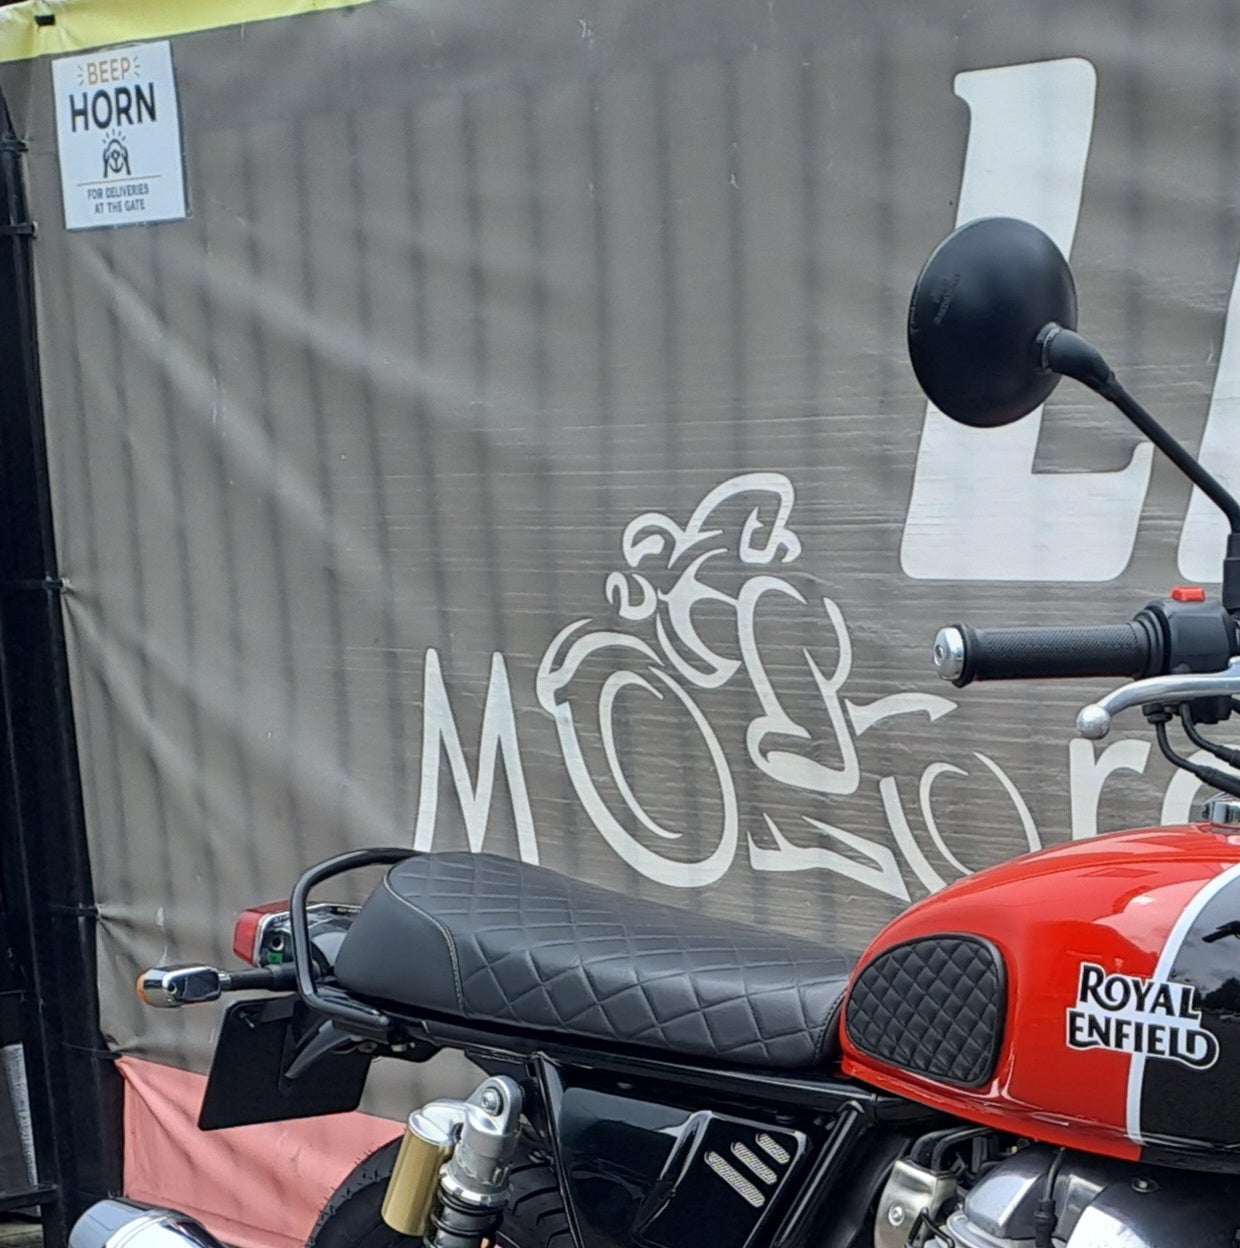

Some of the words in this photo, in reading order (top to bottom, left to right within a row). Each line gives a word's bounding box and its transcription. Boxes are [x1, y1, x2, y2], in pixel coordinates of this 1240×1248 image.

[87, 56, 131, 84] BEEP
[69, 82, 157, 133] HORN
[87, 187, 104, 200] FOR
[105, 183, 149, 199] DELIVERIES
[94, 203, 105, 215] AT
[107, 201, 122, 213] THE
[124, 199, 146, 212] GATE
[1078, 962, 1201, 1020] ROYAL
[1067, 1009, 1221, 1068] ENFIELD
